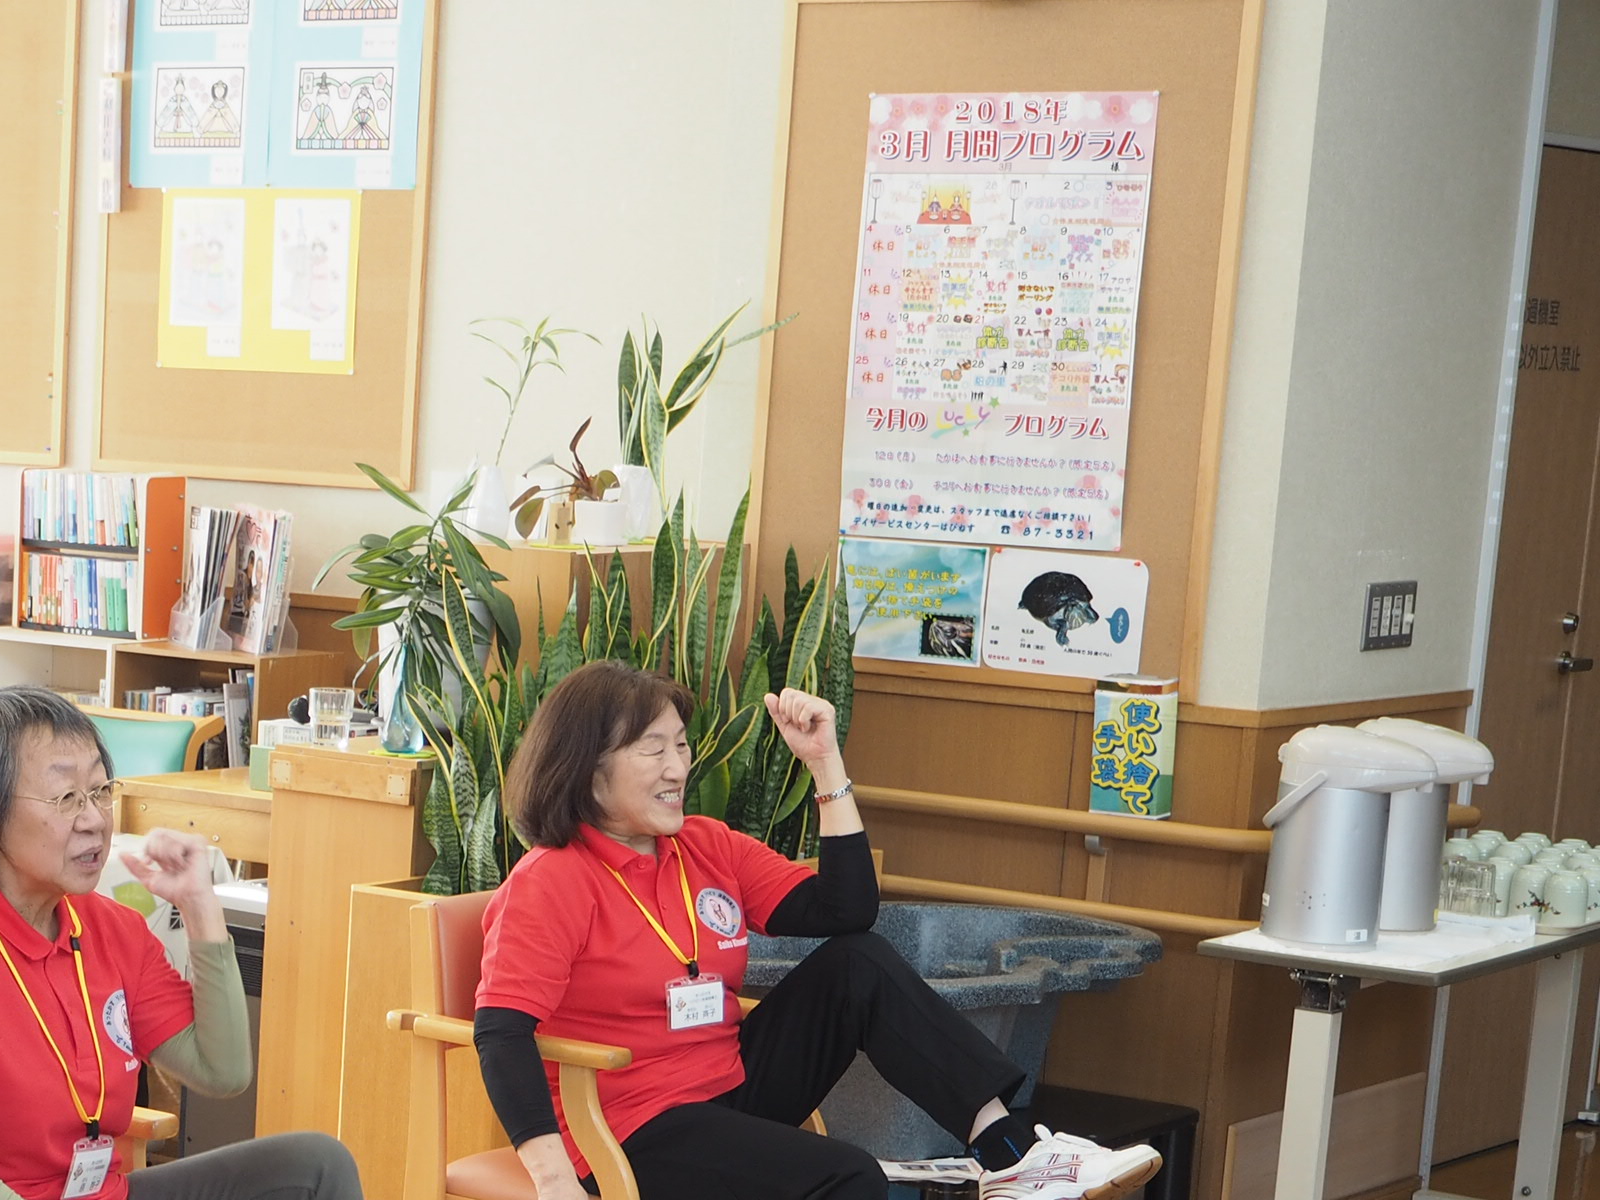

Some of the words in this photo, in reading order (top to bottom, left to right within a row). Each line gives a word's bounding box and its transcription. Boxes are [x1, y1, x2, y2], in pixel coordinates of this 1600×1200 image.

[955, 98, 1067, 125] 2018年
[880, 130, 931, 161] 3月
[945, 129, 1145, 162] 月間プログラム
[873, 239, 895, 253] 休日
[869, 284, 891, 296] 休日
[865, 328, 888, 340] 休日
[862, 371, 884, 384] 休日
[865, 407, 929, 432] 今月の
[1004, 413, 1110, 440] プログラム
[1092, 722, 1123, 786] 手袋
[1122, 700, 1160, 815] 使い捨て
